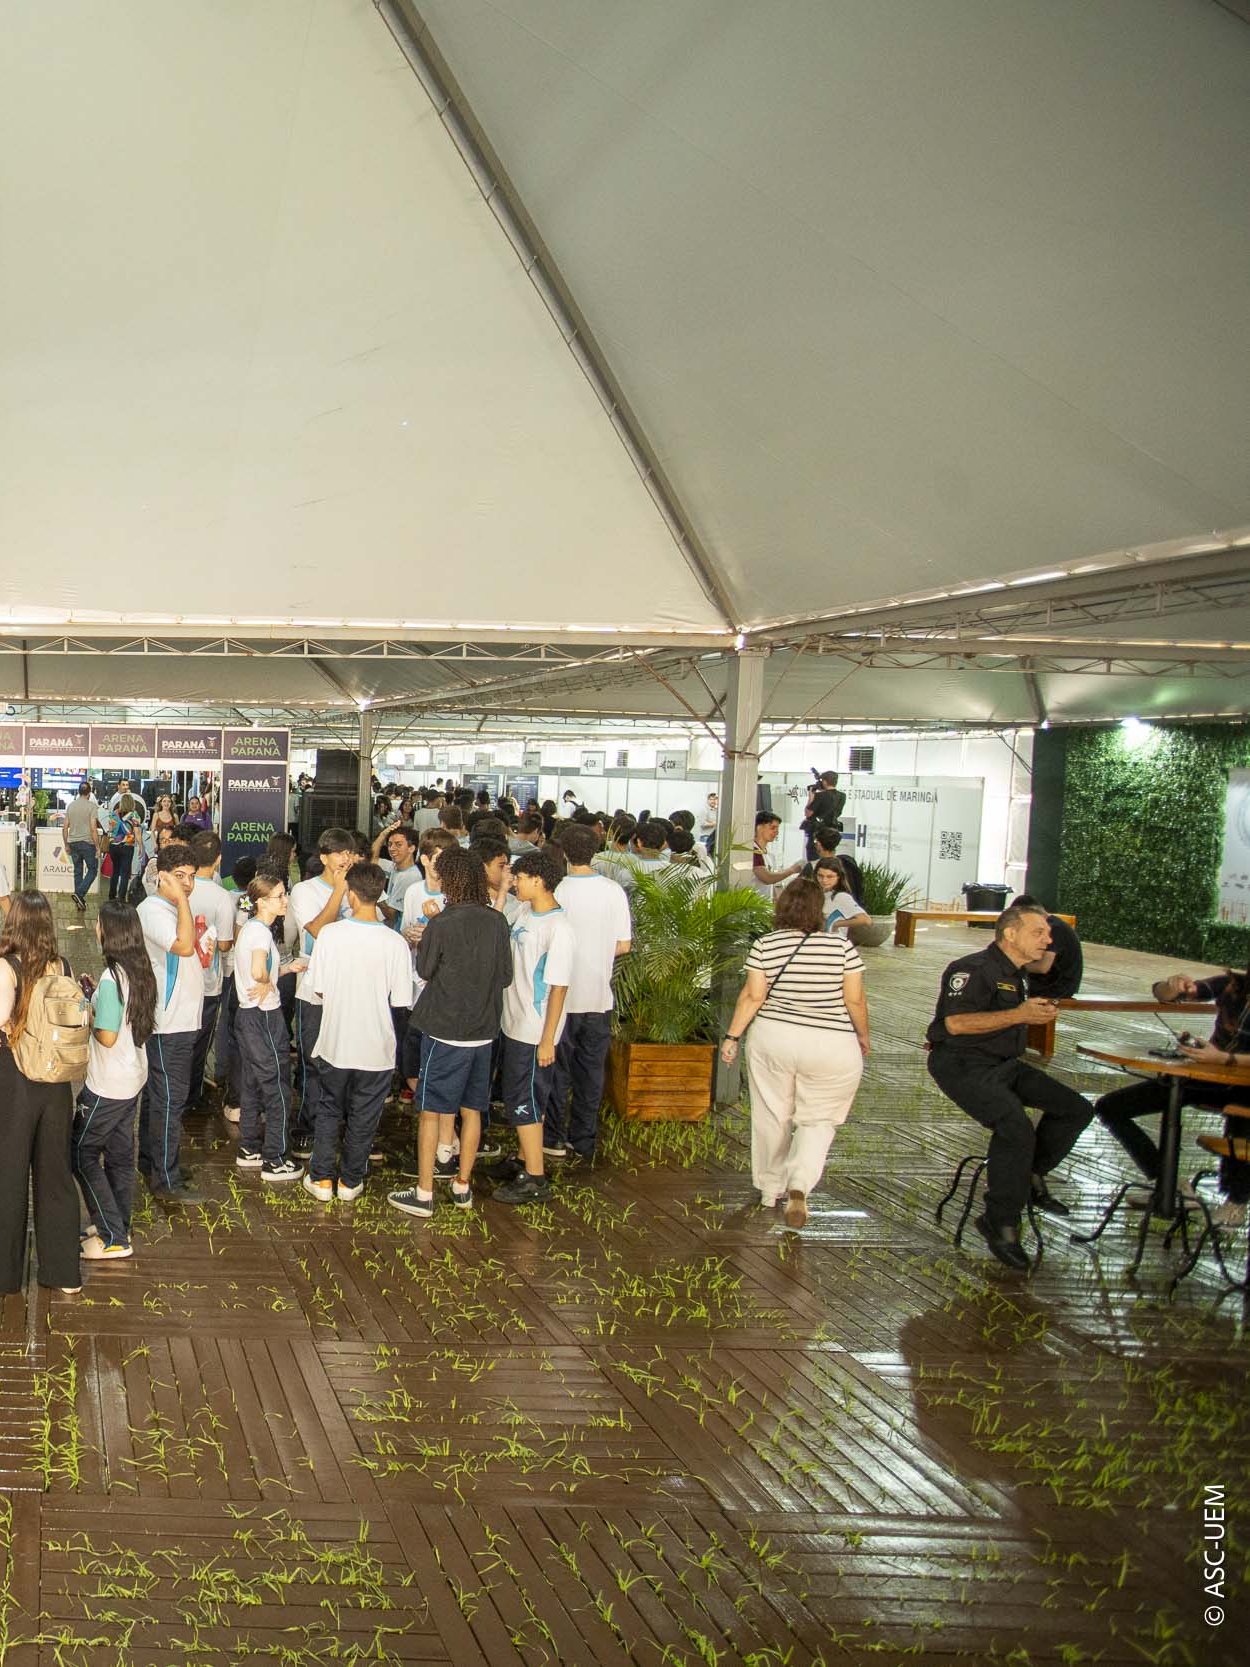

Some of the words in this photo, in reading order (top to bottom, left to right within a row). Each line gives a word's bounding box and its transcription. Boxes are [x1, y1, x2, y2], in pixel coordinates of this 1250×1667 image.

[29, 737, 73, 747] PARANÁ
[102, 734, 144, 743] ARENA
[234, 736, 277, 746] ARENA
[98, 742, 148, 753] PARANÁ
[161, 740, 206, 749] PARANÁ
[230, 745, 281, 756] PARANÁ
[228, 779, 271, 788] PARANÁ
[848, 788, 885, 801] ESTADUAL
[231, 821, 275, 832] ARENA
[227, 832, 270, 842] PARAN
